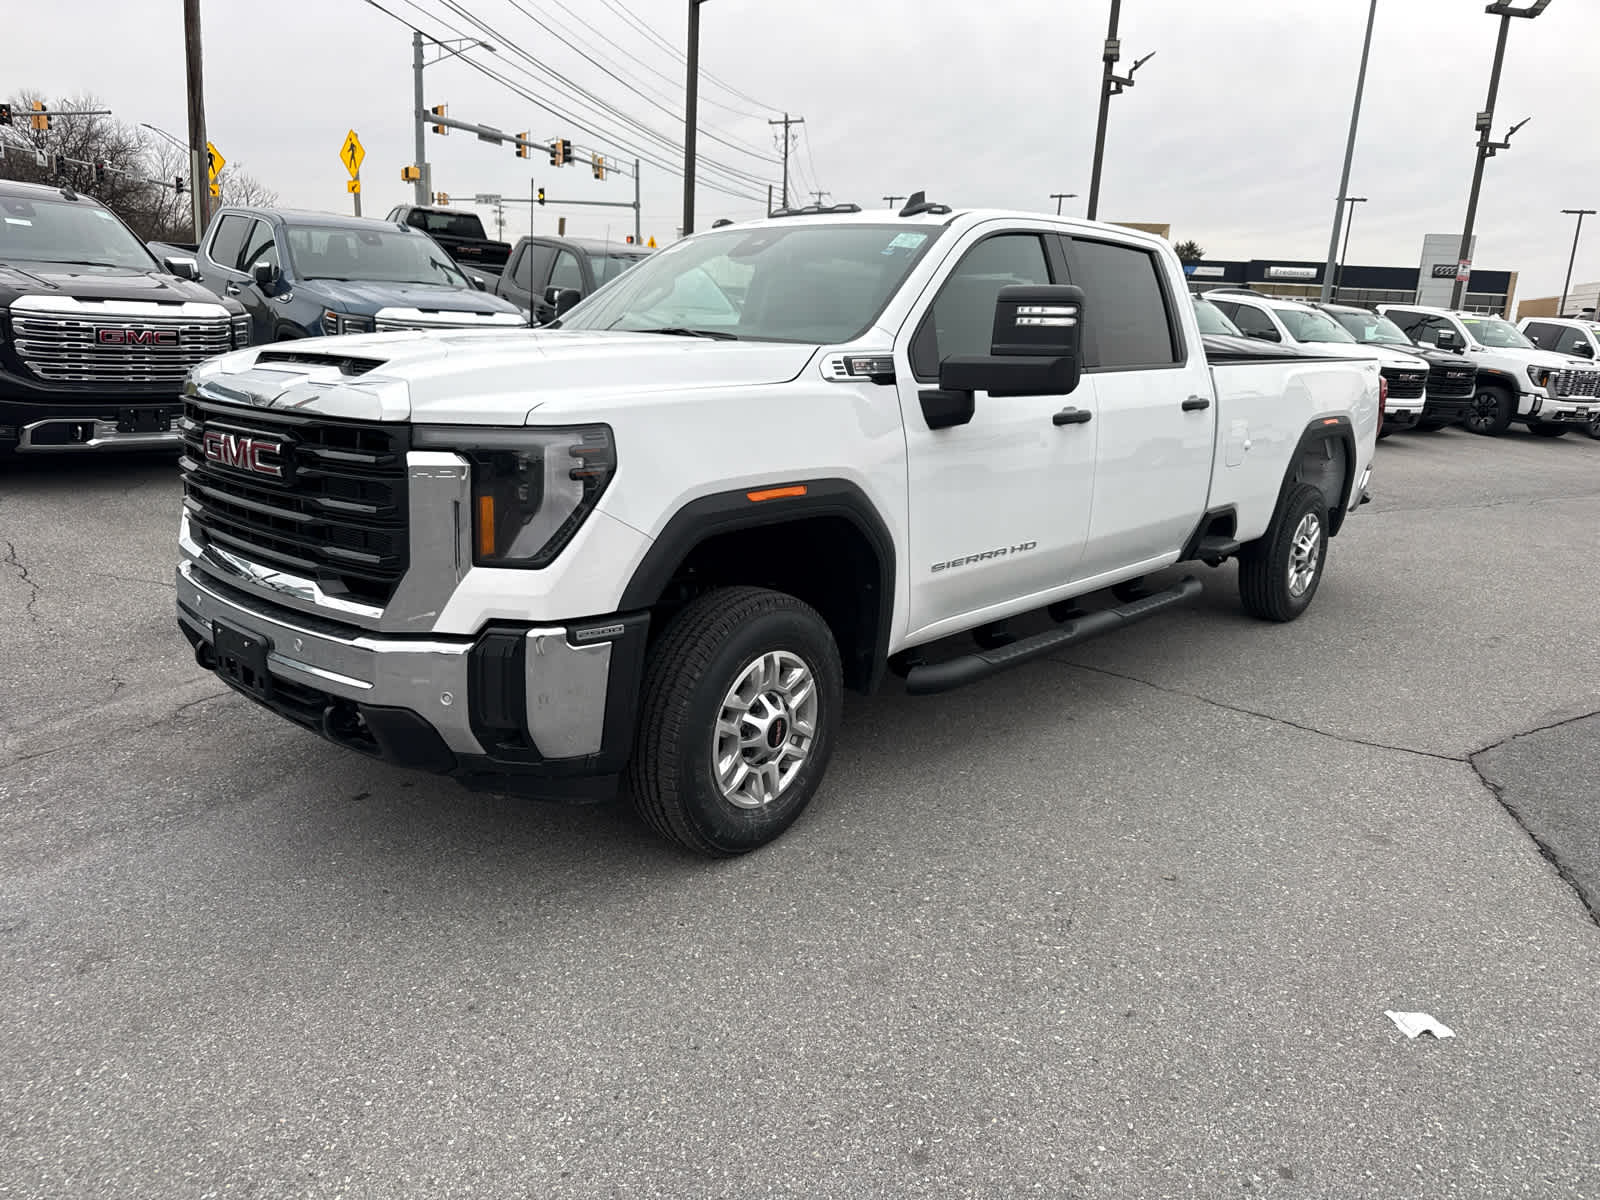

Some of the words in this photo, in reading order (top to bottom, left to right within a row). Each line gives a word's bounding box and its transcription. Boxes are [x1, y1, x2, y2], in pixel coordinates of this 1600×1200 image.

[99, 329, 177, 345] GMC
[203, 431, 282, 477] GMC
[930, 548, 1007, 572] SIERRA
[1010, 541, 1037, 554] HD
